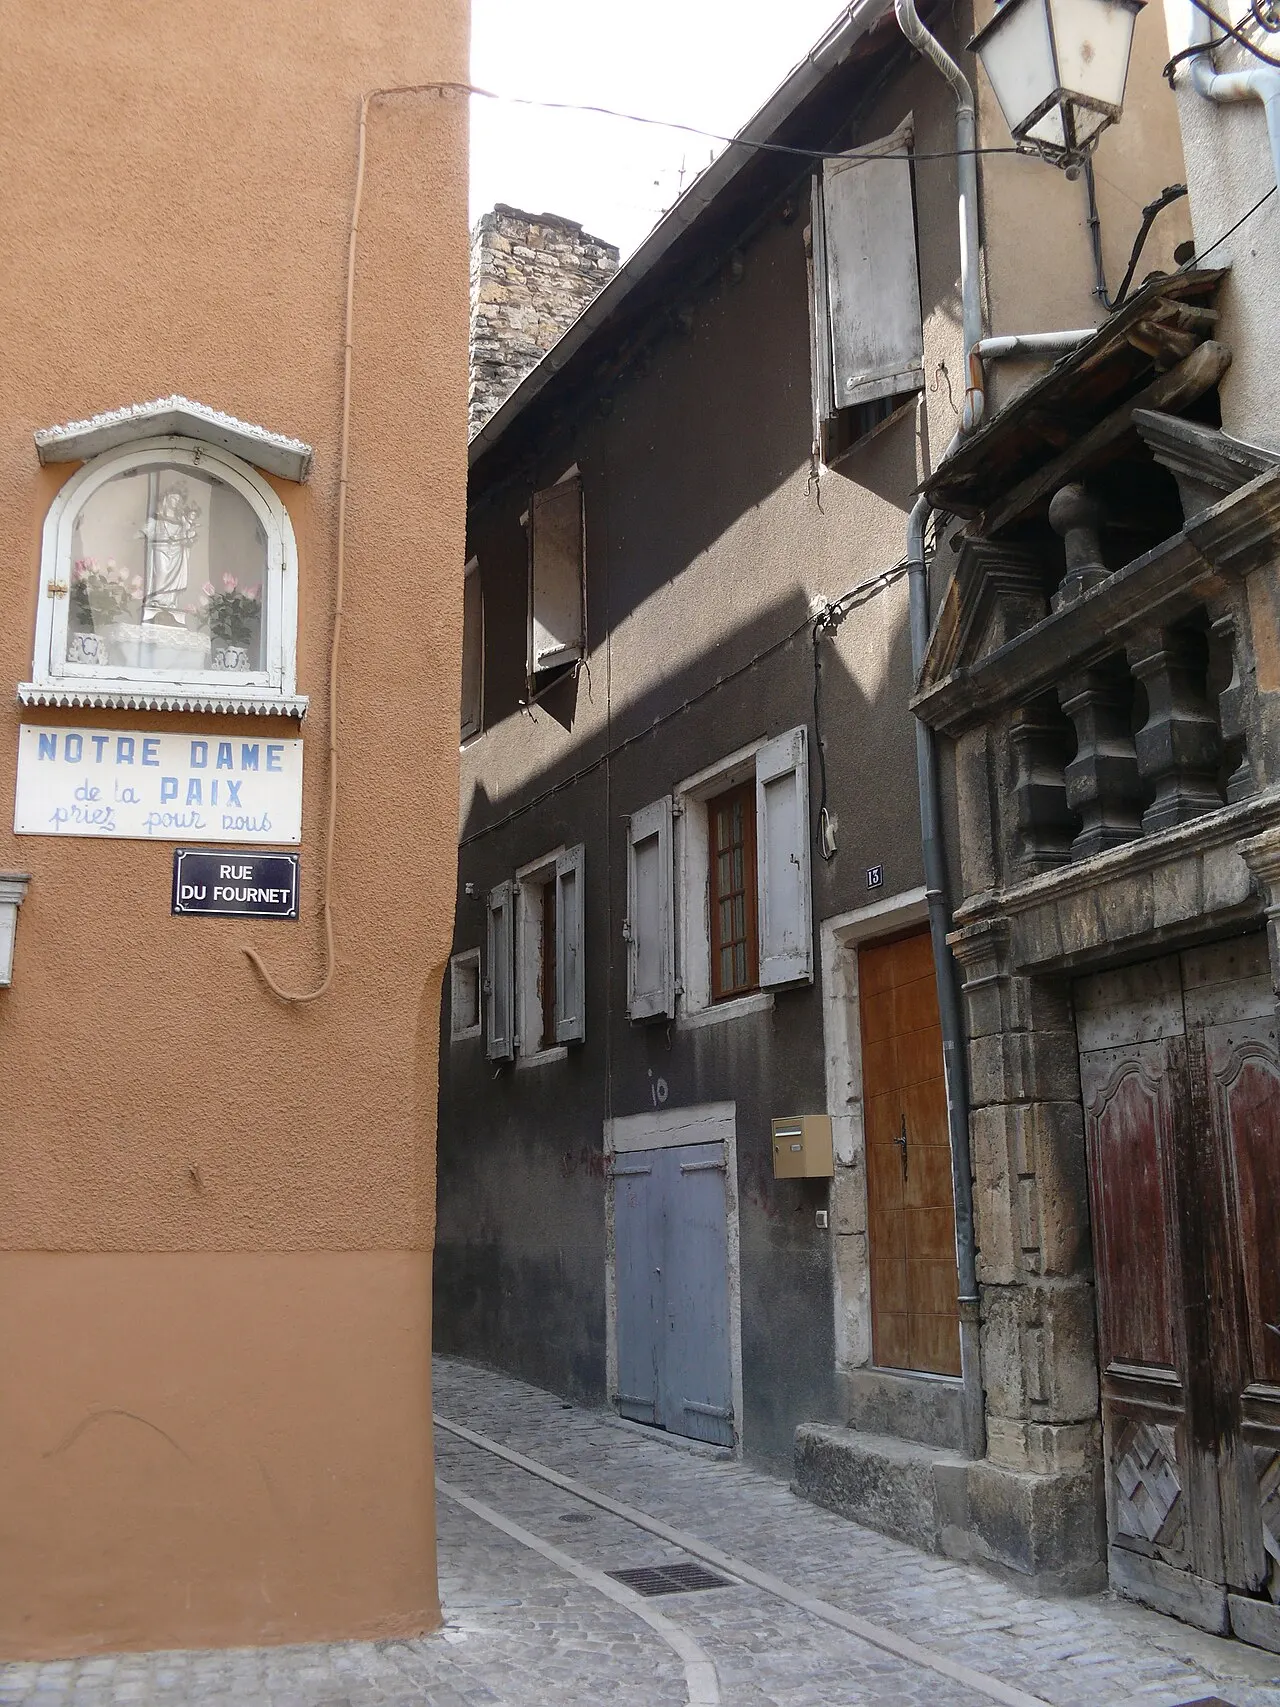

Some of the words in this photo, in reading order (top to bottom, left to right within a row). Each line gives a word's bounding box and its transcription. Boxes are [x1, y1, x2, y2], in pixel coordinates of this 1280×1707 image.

[38, 733, 161, 766] NOTRE
[190, 741, 284, 772] DAME
[74, 778, 101, 801] de
[114, 777, 141, 804] la
[160, 777, 243, 807] PAIX
[49, 804, 116, 832] priez
[142, 811, 206, 834] pour
[222, 813, 273, 832] nous
[220, 864, 253, 880] RUE
[868, 869, 879, 886] 13
[181, 885, 207, 900] DU
[213, 886, 291, 904] FOURNET
